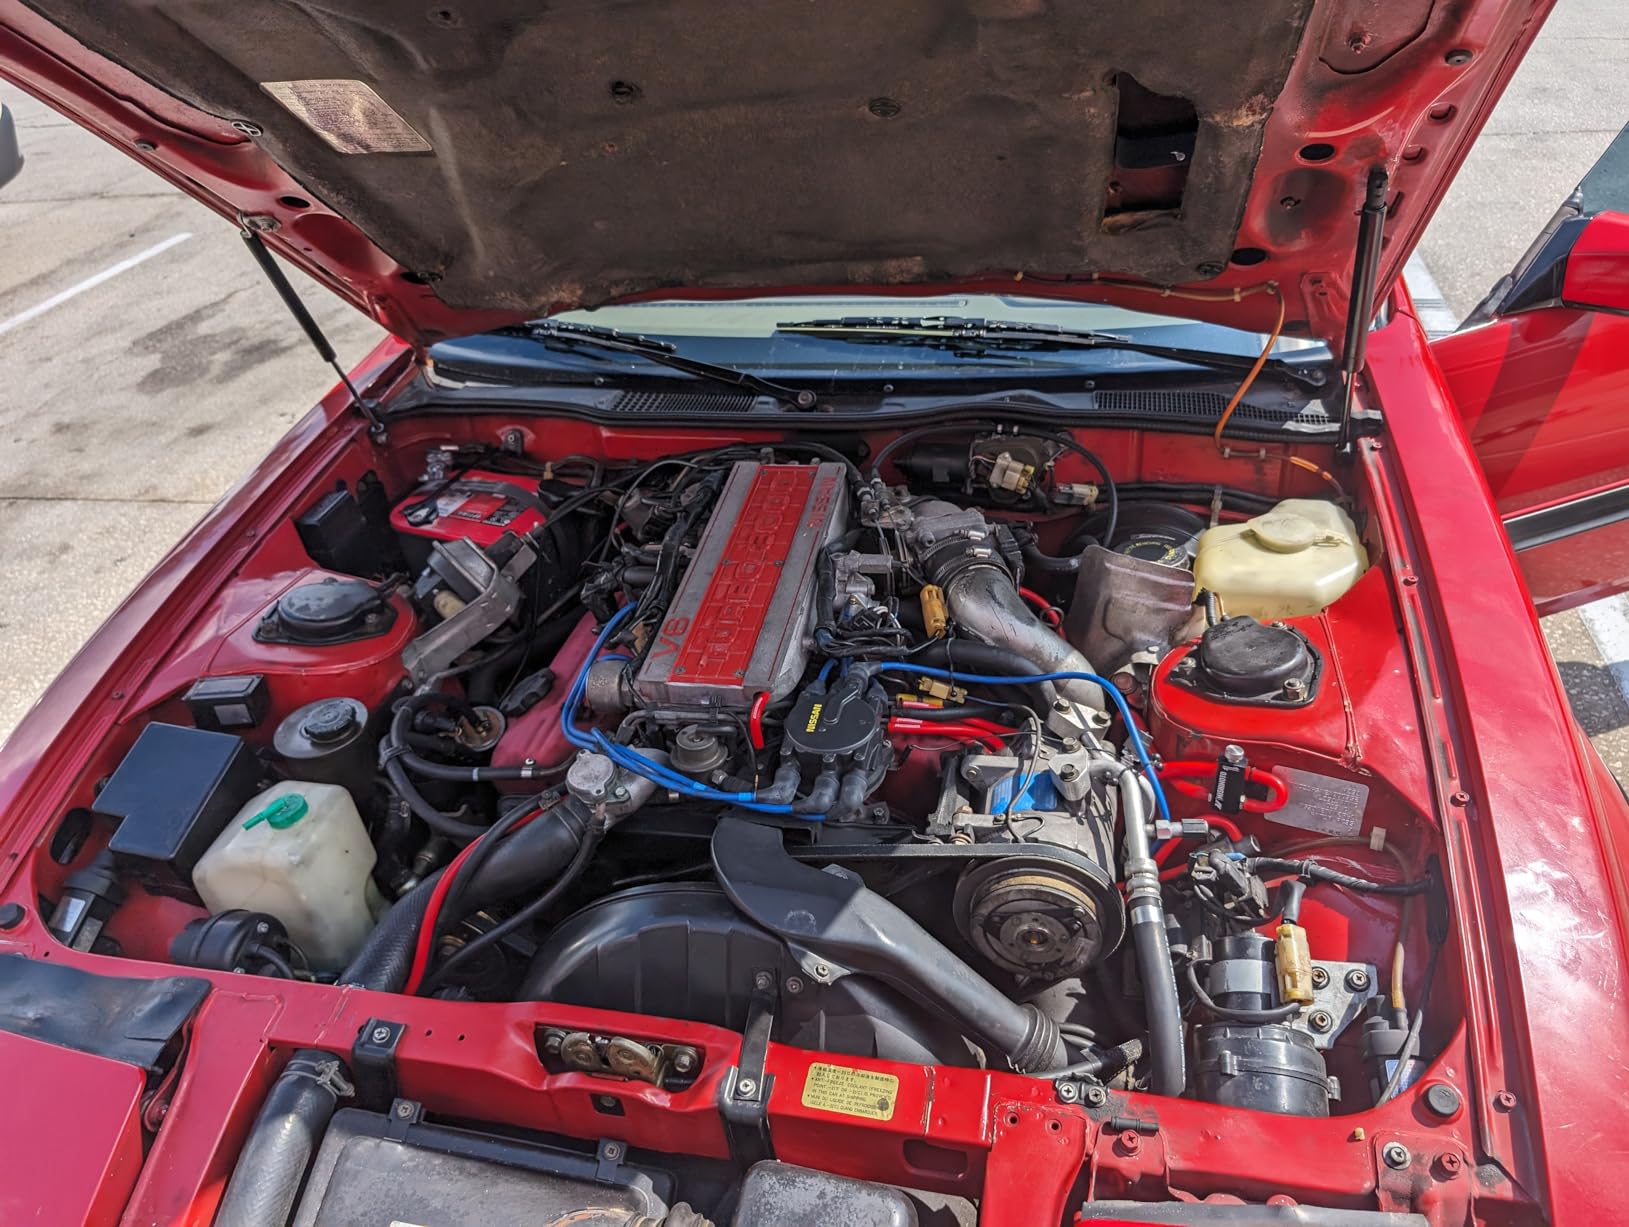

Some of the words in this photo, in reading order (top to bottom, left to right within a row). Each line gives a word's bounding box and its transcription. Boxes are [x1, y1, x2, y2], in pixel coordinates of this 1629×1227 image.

[806, 476, 837, 528] NISSAN
[649, 616, 691, 660] V6
[697, 560, 762, 668] TURBO
[805, 703, 823, 734] NISSAN
